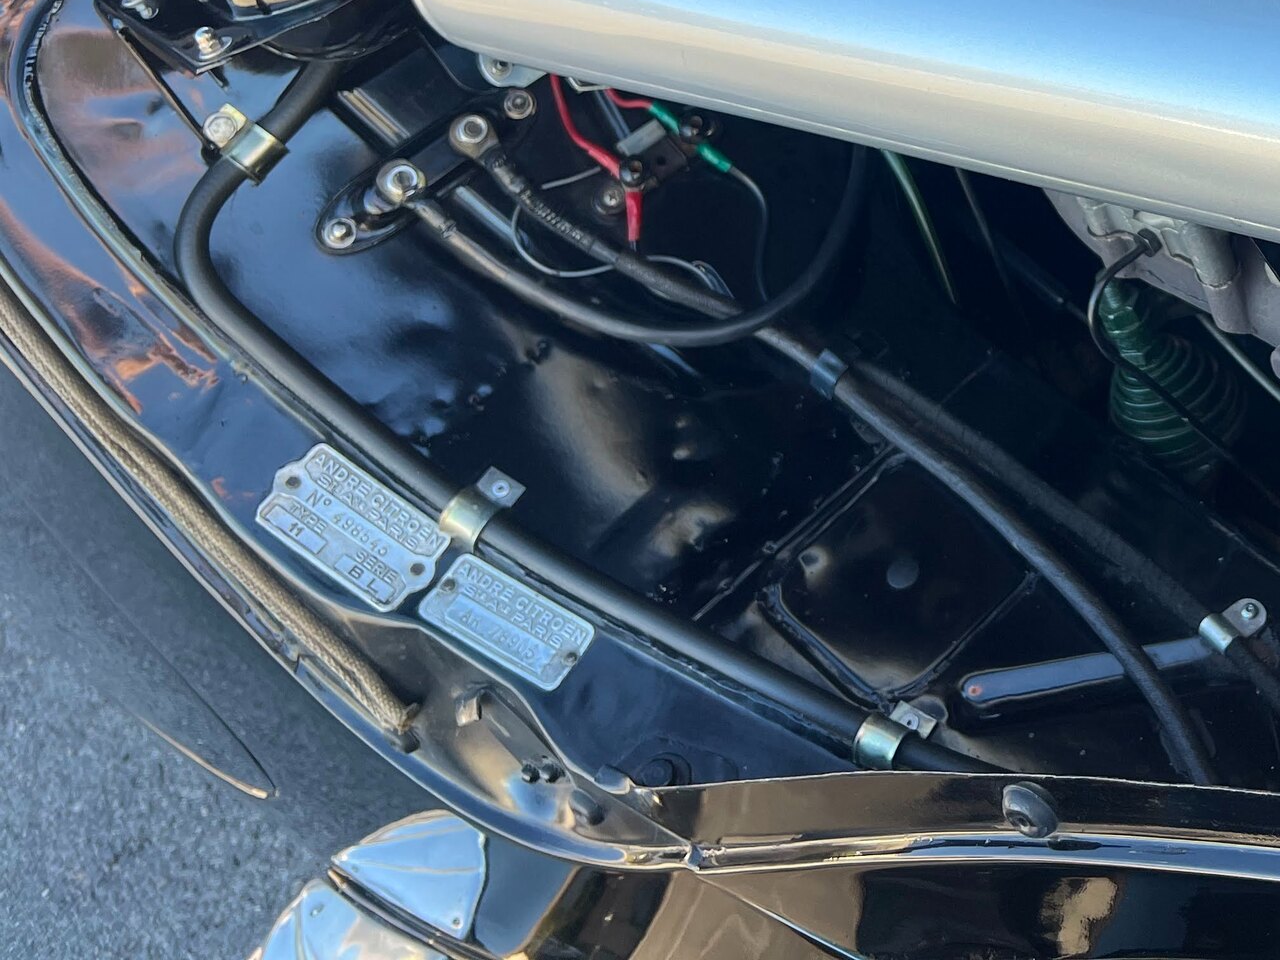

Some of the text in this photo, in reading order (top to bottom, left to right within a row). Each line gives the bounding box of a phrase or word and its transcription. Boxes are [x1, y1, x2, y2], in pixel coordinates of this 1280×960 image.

[288, 502, 327, 535] TYPE
[288, 522, 303, 537] 11
[364, 509, 419, 551] PARIS
[510, 615, 564, 649] PARIS
